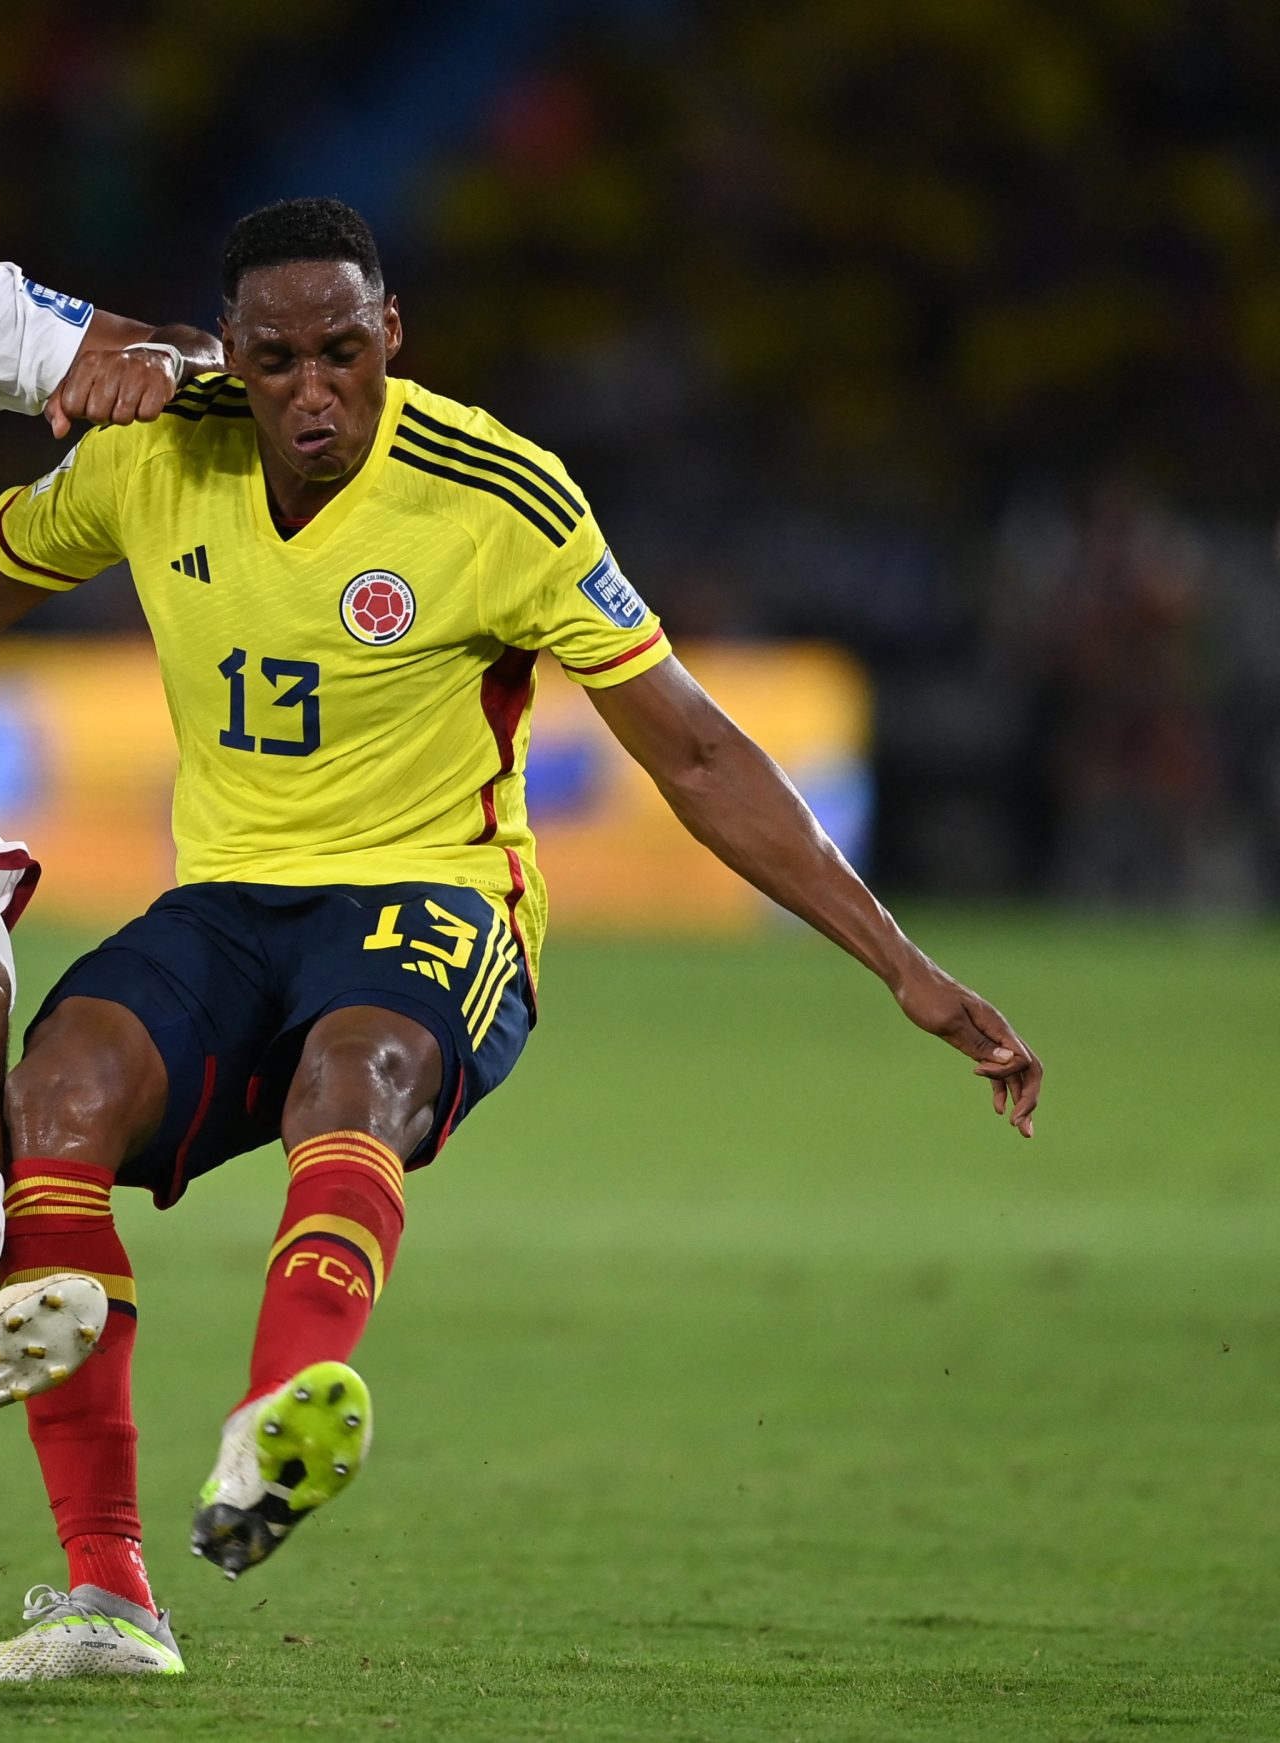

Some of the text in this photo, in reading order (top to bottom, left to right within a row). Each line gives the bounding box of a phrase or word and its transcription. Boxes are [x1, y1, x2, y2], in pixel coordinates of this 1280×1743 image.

[594, 564, 617, 592] FOOTB
[218, 647, 320, 757] 13
[363, 899, 478, 969] 13
[81, 1641, 117, 1650] PREDATOR
